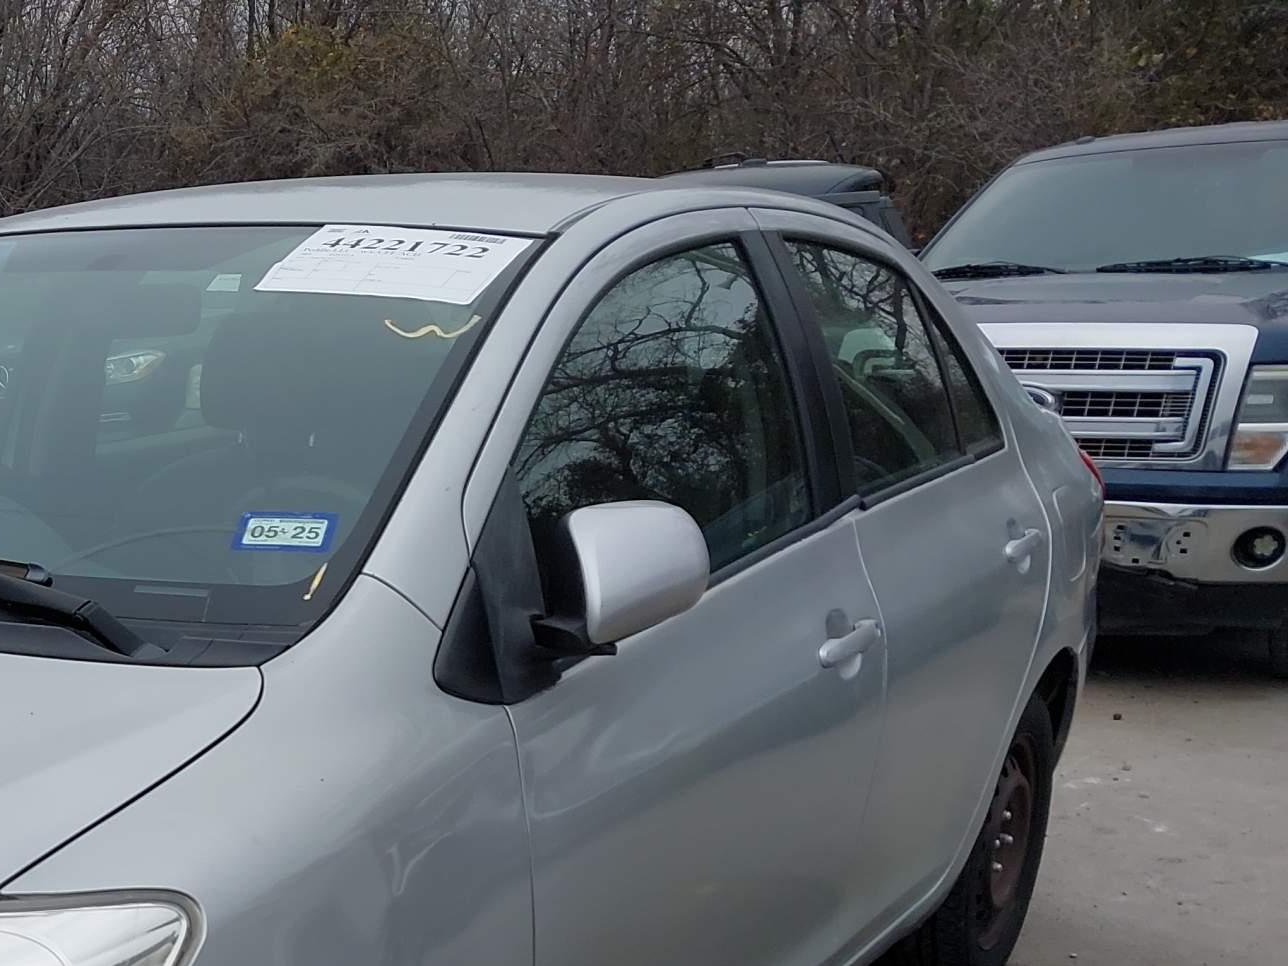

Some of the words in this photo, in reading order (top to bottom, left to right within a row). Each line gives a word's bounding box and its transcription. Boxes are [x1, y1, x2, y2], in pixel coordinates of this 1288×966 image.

[321, 236, 490, 258] 44221722
[250, 525, 280, 539] 05
[290, 526, 321, 540] 25
